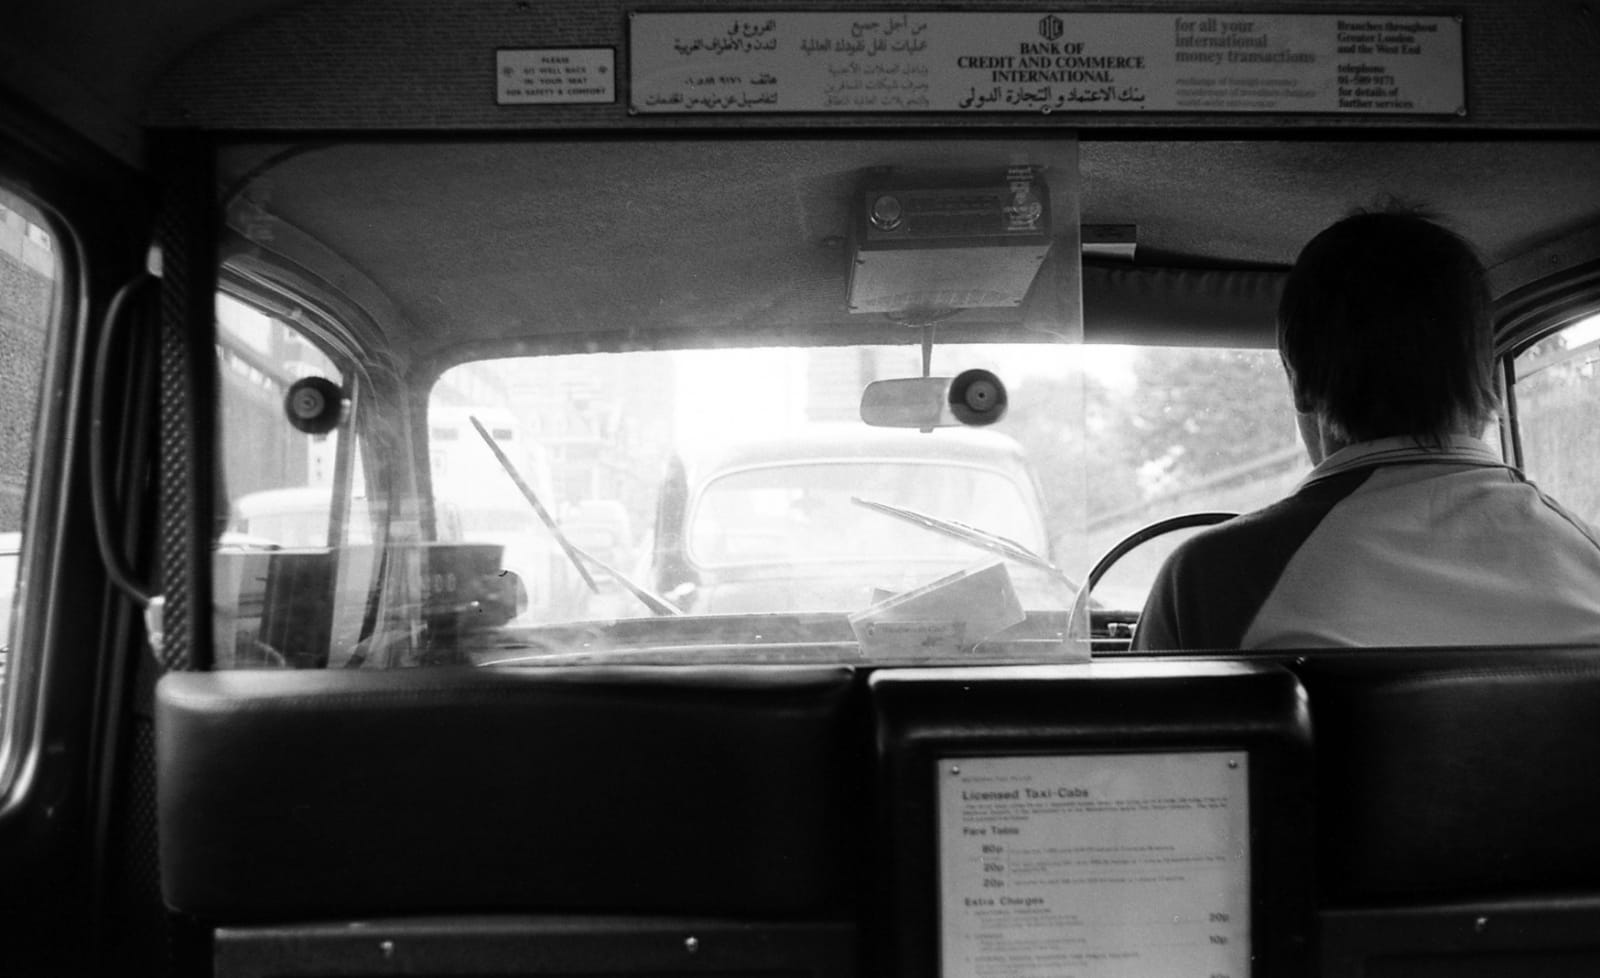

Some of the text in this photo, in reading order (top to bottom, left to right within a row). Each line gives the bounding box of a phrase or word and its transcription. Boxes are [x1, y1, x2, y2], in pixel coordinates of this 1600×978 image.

[851, 22, 880, 38] جميع
[1175, 17, 1254, 34] for all your
[1337, 20, 1438, 33] Branches throughout
[1175, 33, 1267, 48] international
[1337, 32, 1415, 43] Greater London
[1020, 42, 1085, 55] BANK OF
[1337, 44, 1421, 55] and the West End
[957, 56, 1145, 69] CREDIT AND COMMERCE
[1175, 49, 1316, 66] money transactions
[1337, 64, 1385, 75] telephone
[992, 70, 1114, 83] INTERNATIONAL
[1067, 87, 1116, 102] الاعتماد
[1119, 87, 1146, 109] بنك
[1338, 86, 1399, 97] for details of
[1339, 99, 1414, 108] further services
[962, 790, 1019, 801] Licensed
[963, 827, 987, 835] Fare
[964, 896, 1044, 907] Extra Charges
